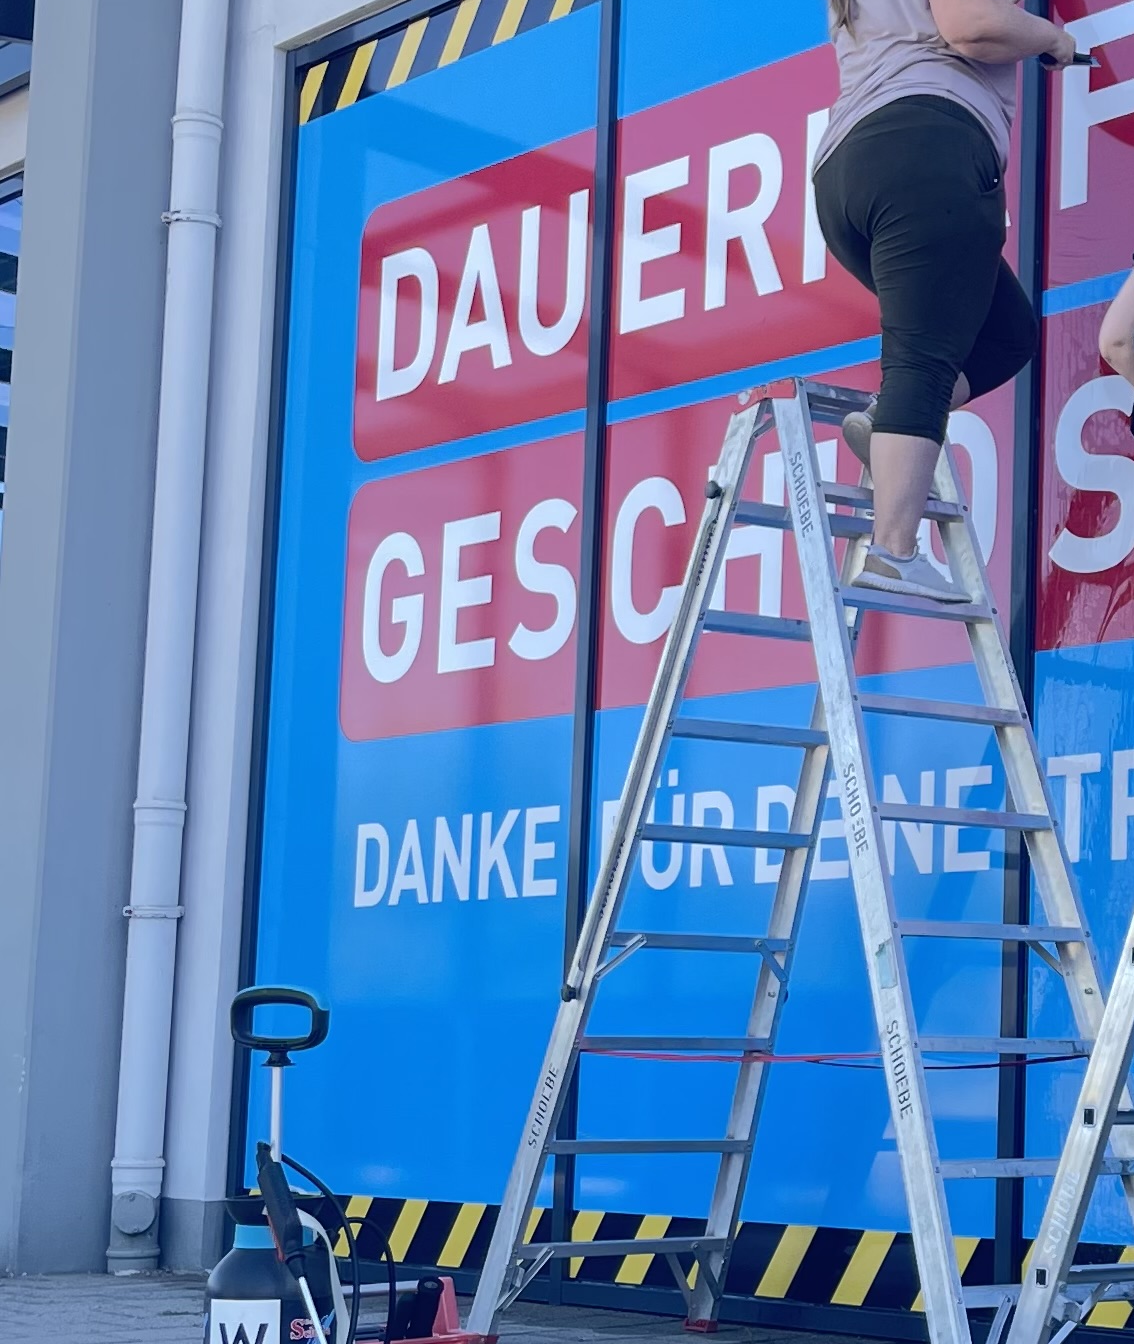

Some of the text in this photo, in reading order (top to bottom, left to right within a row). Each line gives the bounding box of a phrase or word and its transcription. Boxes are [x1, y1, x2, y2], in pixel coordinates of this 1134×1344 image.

[789, 451, 814, 538] SCHOEBE
[353, 805, 560, 908] DANKE
[754, 765, 993, 885] DENE
[886, 1019, 914, 1120] SCHOEBE
